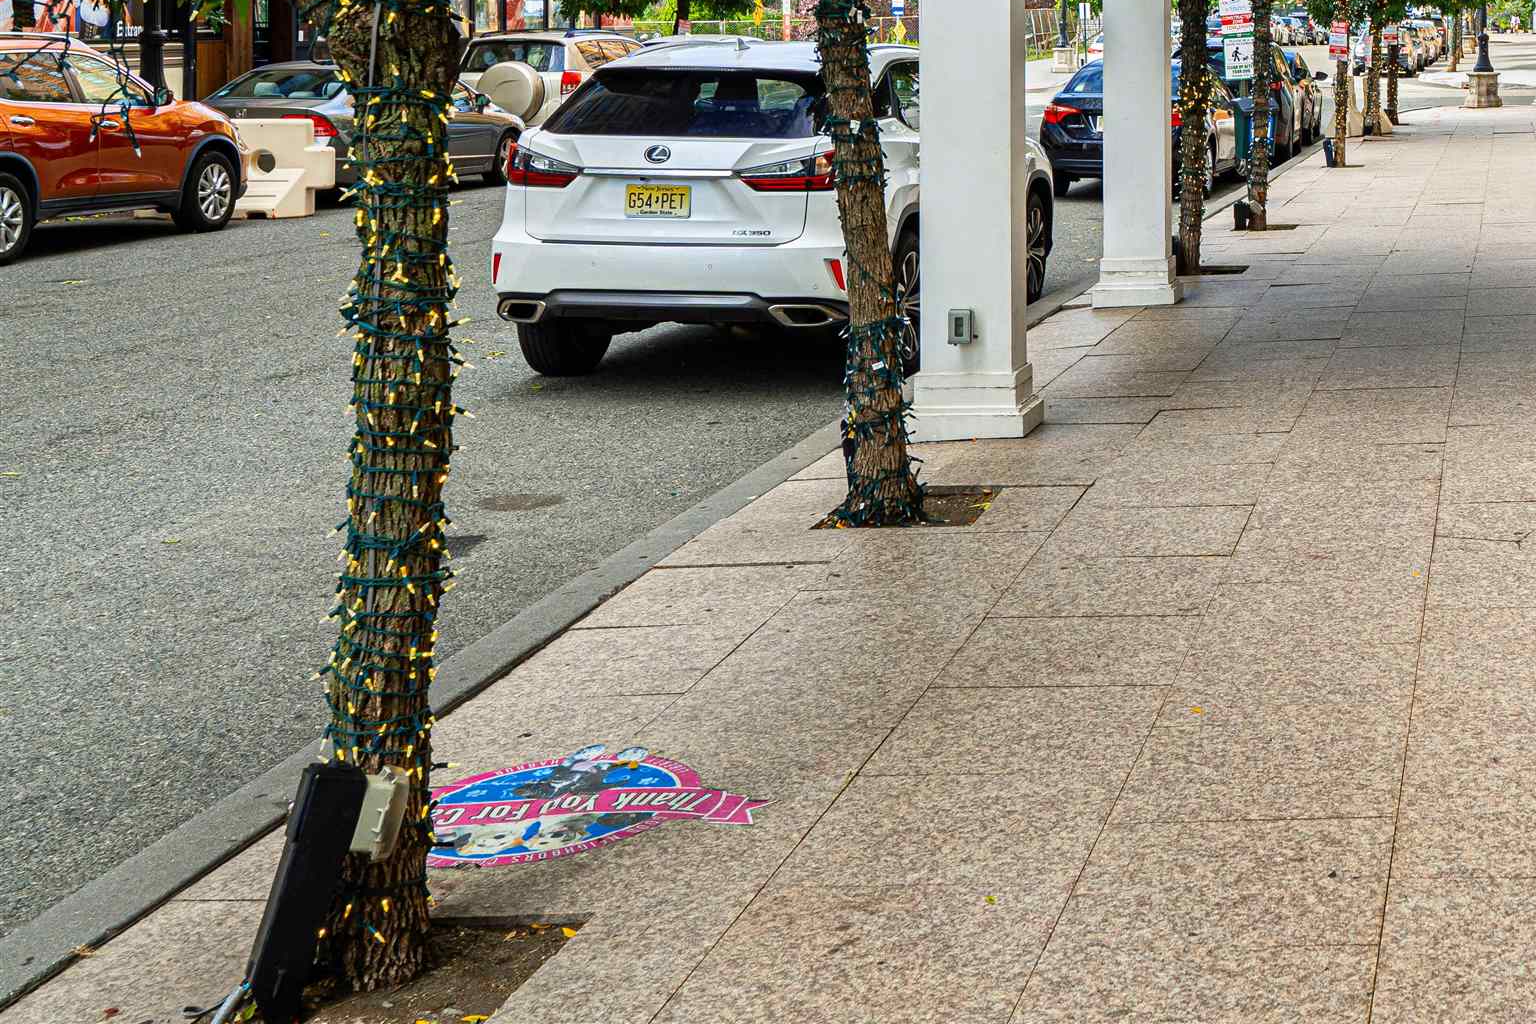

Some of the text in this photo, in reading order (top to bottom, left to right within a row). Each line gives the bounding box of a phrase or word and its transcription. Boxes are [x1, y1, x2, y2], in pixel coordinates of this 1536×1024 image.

[628, 192, 686, 209] G54 PET
[470, 802, 531, 820] For
[539, 794, 599, 814] You
[611, 792, 712, 812] Thank
